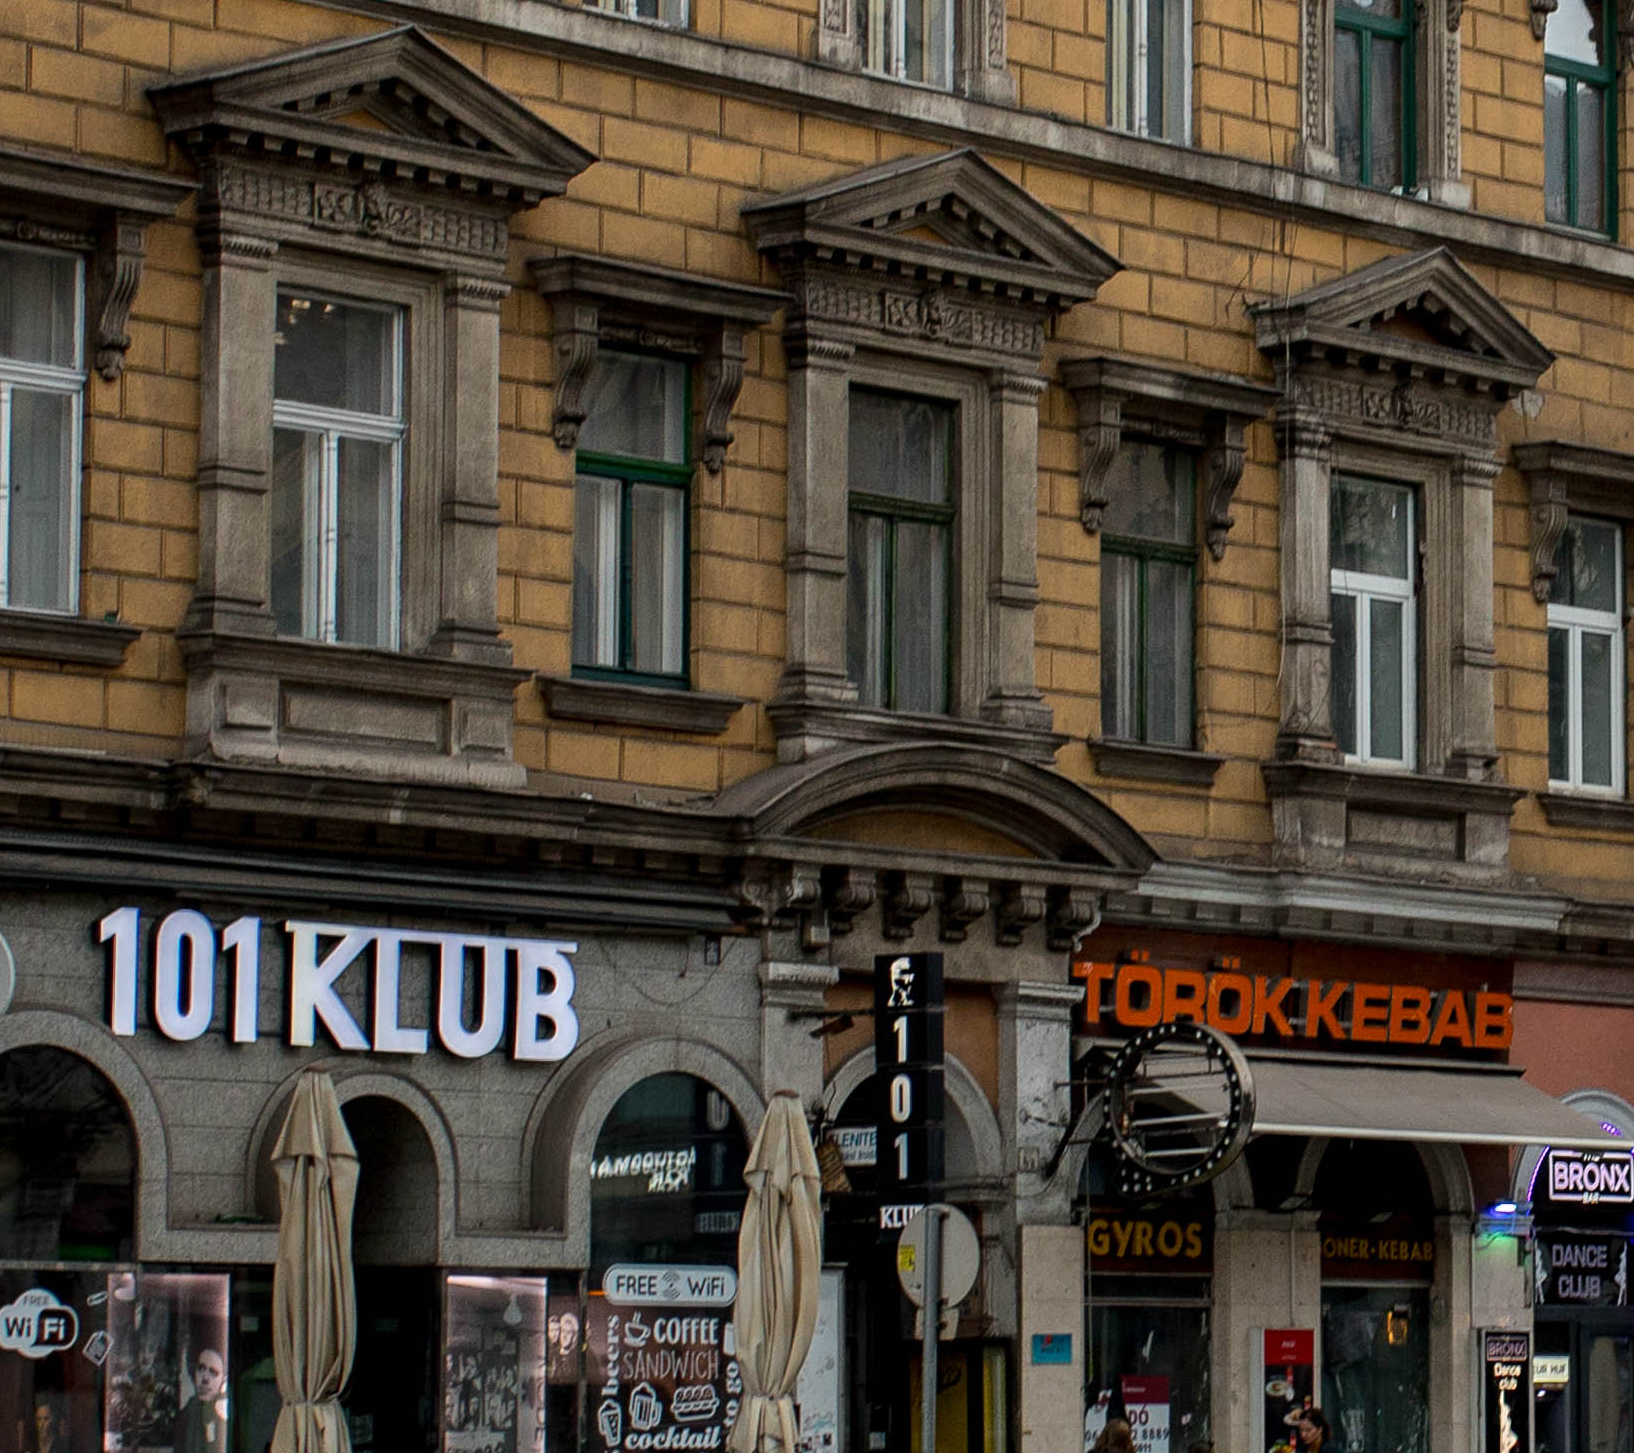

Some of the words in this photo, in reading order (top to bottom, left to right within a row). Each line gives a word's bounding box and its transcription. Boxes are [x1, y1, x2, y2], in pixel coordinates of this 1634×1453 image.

[98, 907, 261, 1042] 101
[285, 920, 580, 1062] KLUB
[1072, 949, 1295, 1036] TÖRÖK
[1306, 978, 1515, 1049] KEBAB
[1554, 1160, 1630, 1193] BRONX
[880, 1204, 930, 1229] KLU
[1088, 1216, 1204, 1260] GYROS
[1378, 1238, 1434, 1261] KEBAB
[1552, 1243, 1608, 1269] DANCE
[616, 1274, 658, 1296] FREE
[687, 1275, 726, 1297] WiFi
[1557, 1273, 1602, 1299] CLUB
[652, 1316, 720, 1346] COFFEE
[622, 1348, 721, 1381] SANDWICH
[624, 1424, 722, 1451] cocktail
